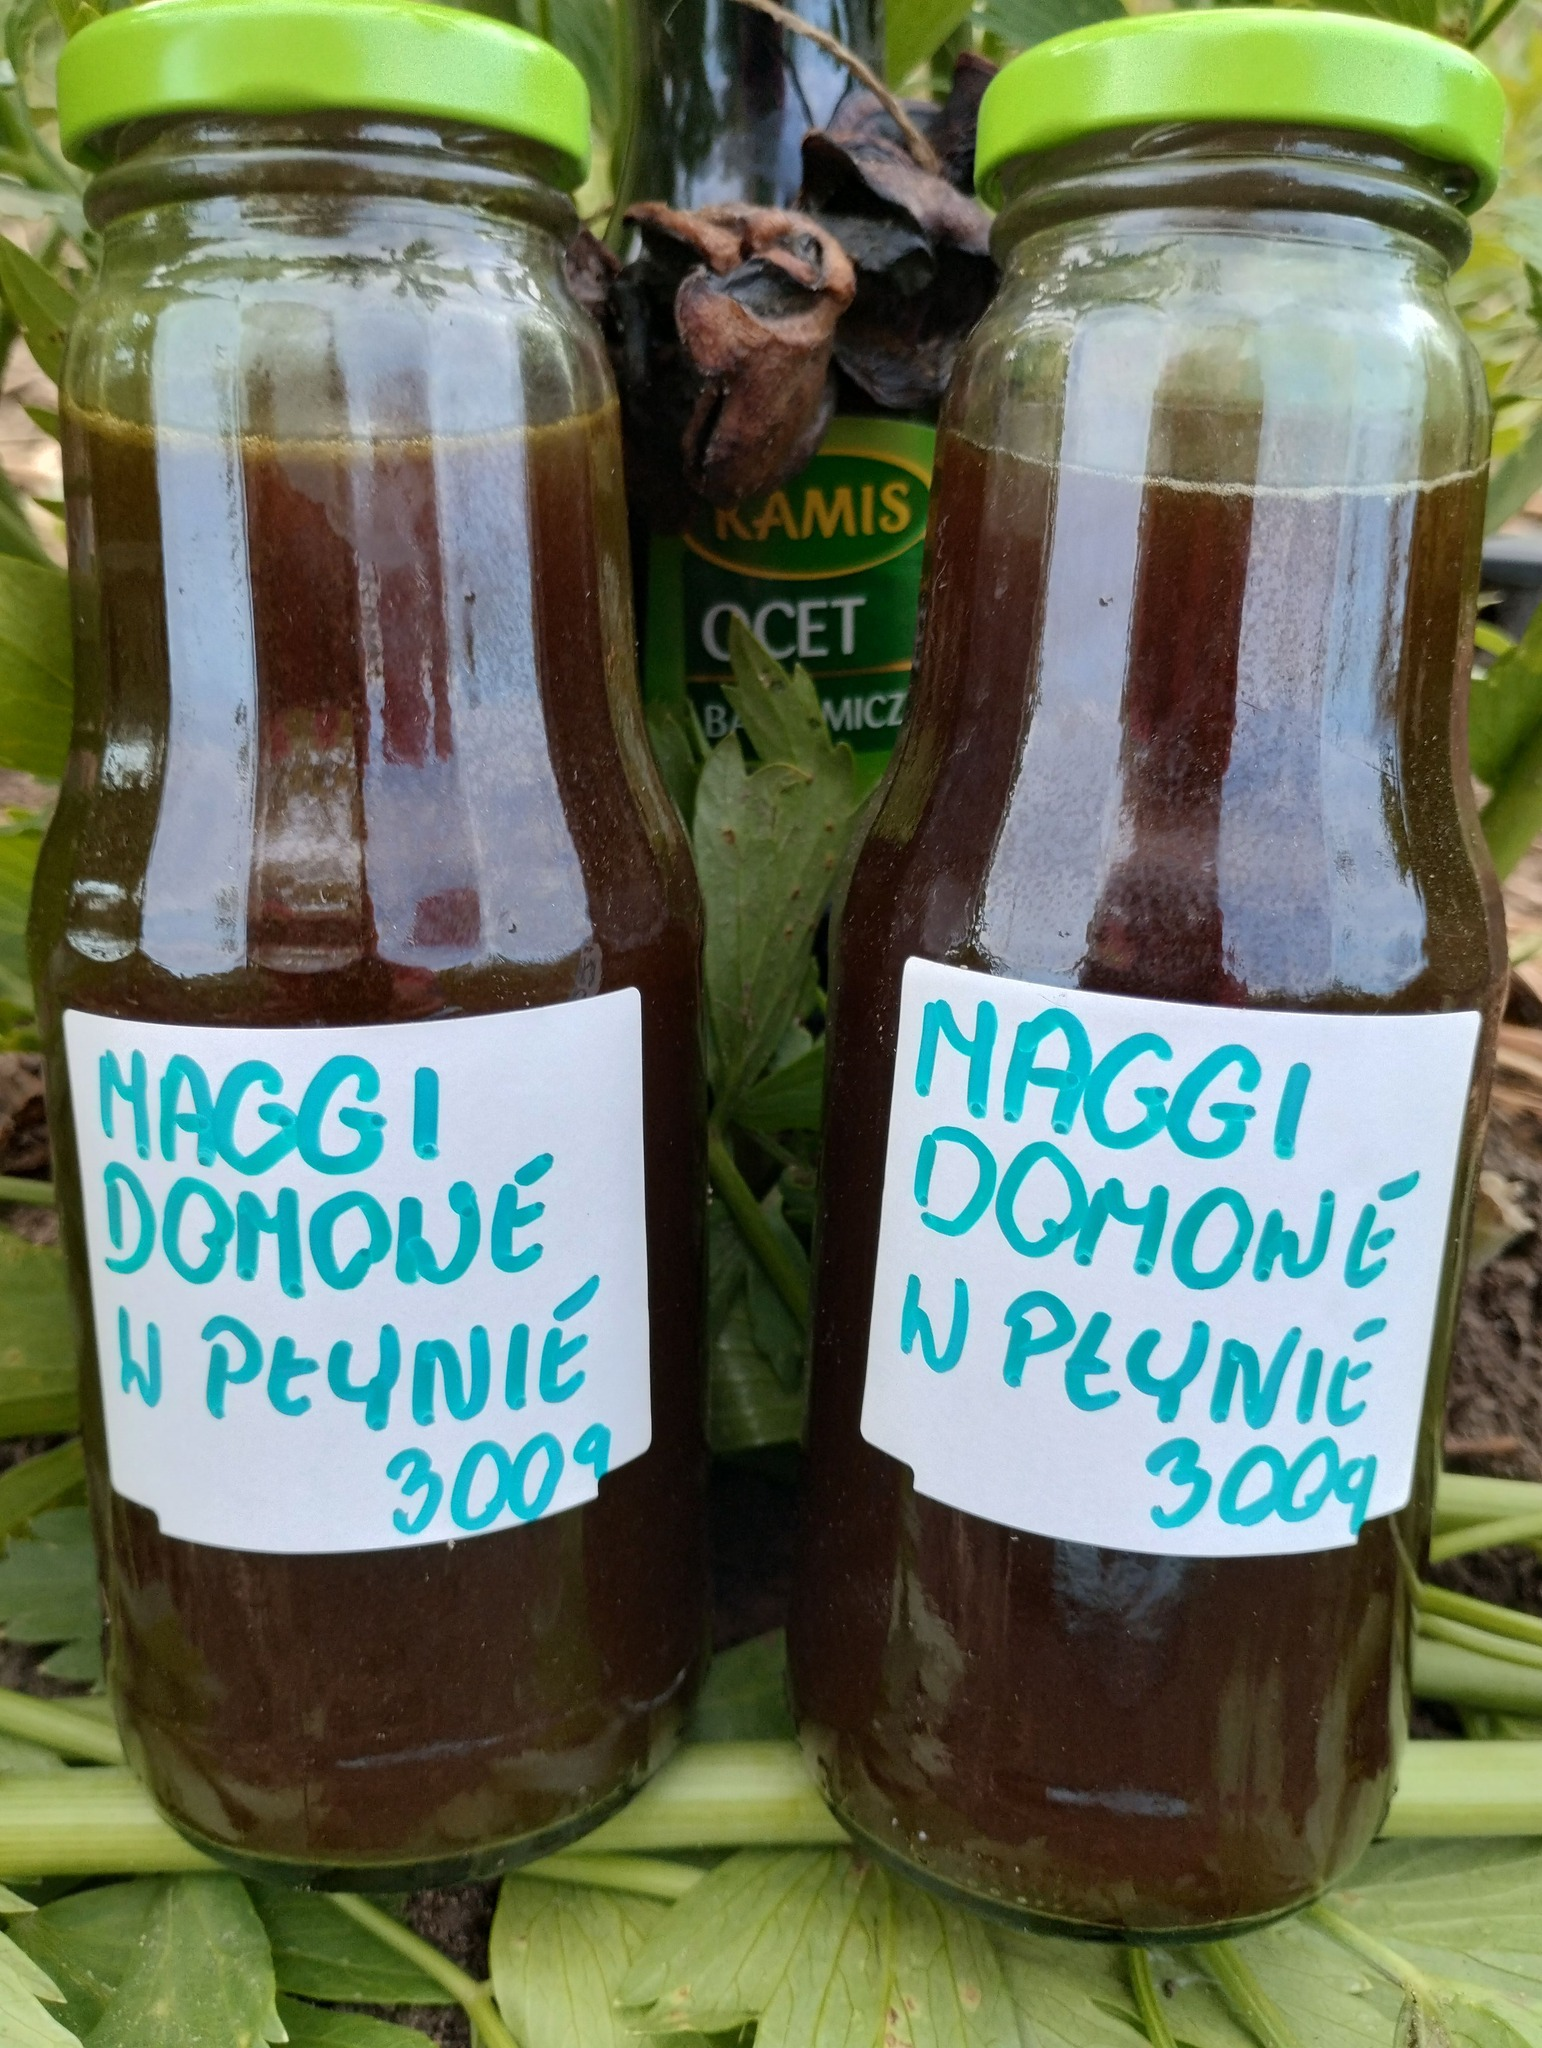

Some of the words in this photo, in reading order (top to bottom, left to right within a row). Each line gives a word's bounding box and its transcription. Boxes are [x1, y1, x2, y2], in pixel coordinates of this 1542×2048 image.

[702, 597, 867, 663] OCET
[99, 1049, 440, 1177] MAGGI
[914, 999, 1312, 1160] MAGGI
